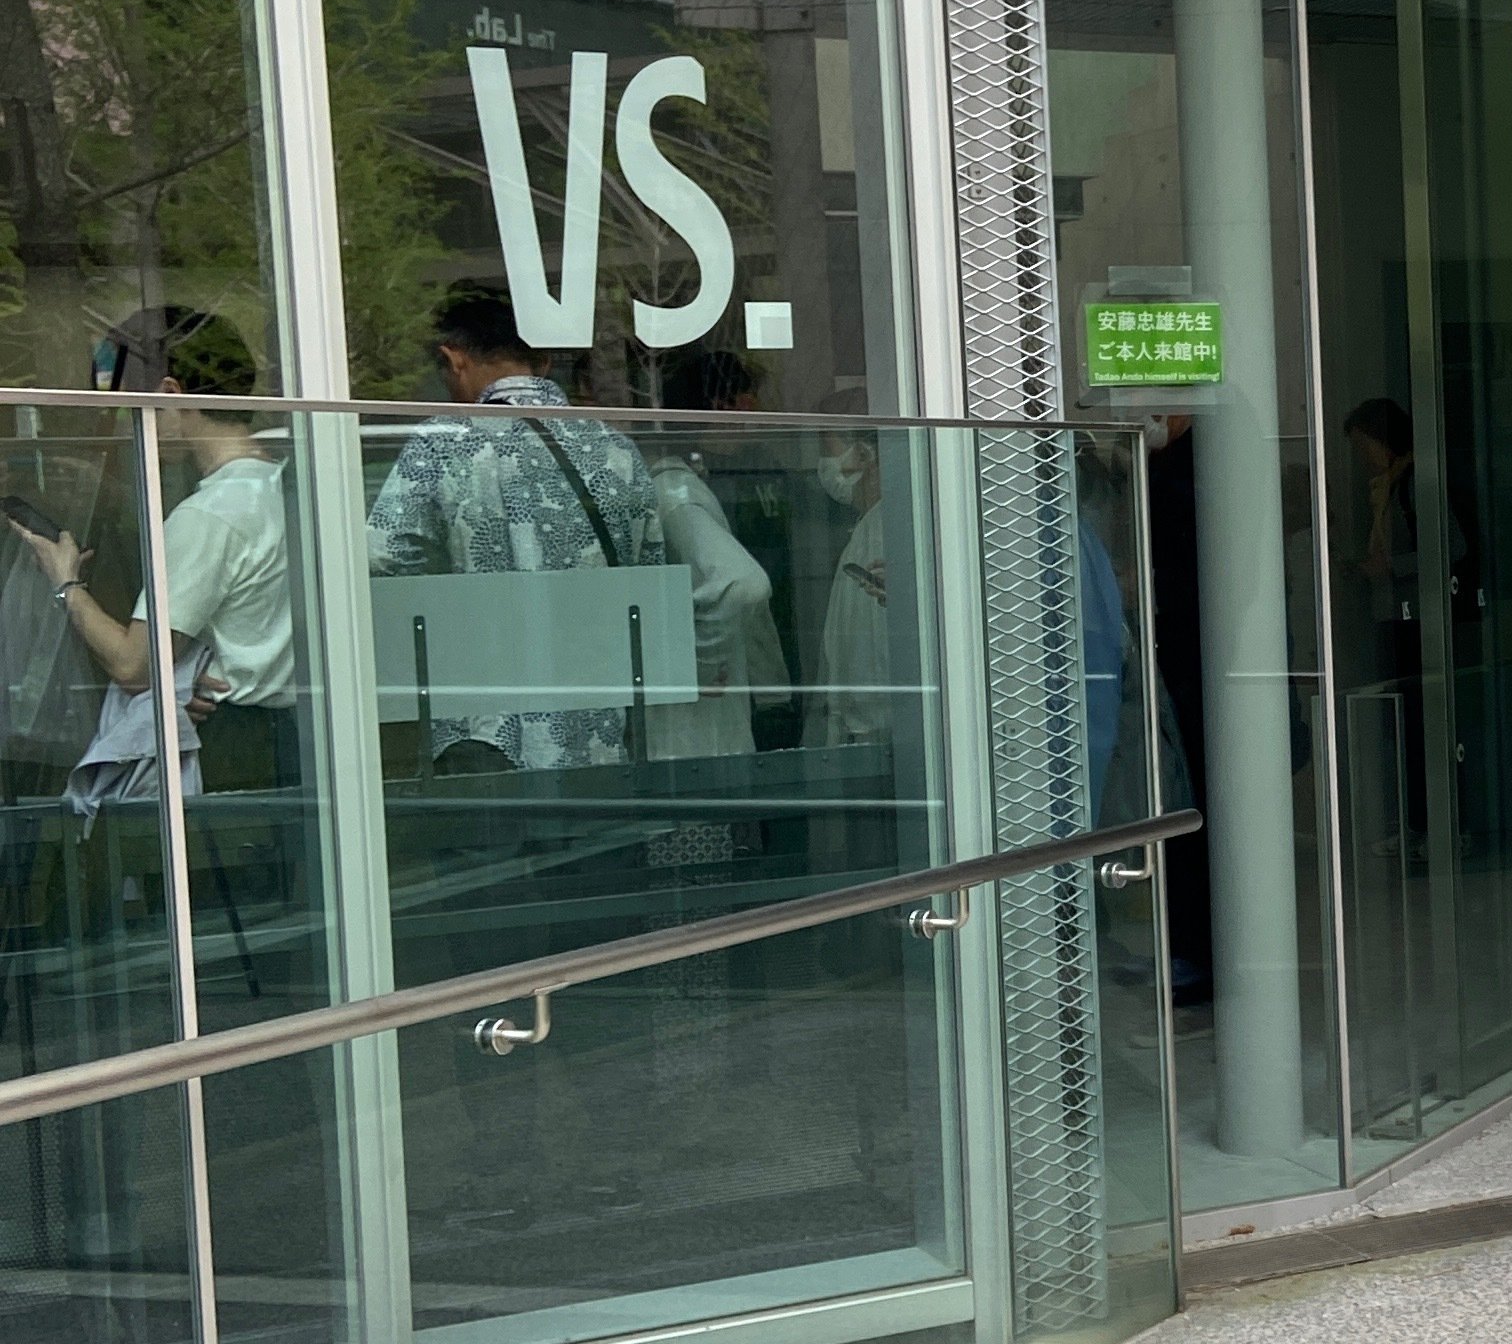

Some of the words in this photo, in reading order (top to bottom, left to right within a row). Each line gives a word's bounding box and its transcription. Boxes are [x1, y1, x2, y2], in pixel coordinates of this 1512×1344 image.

[466, 47, 793, 348] VS.
[1098, 311, 1213, 332] 安藤忠雄先生
[1098, 341, 1217, 362] ご本人来館中!
